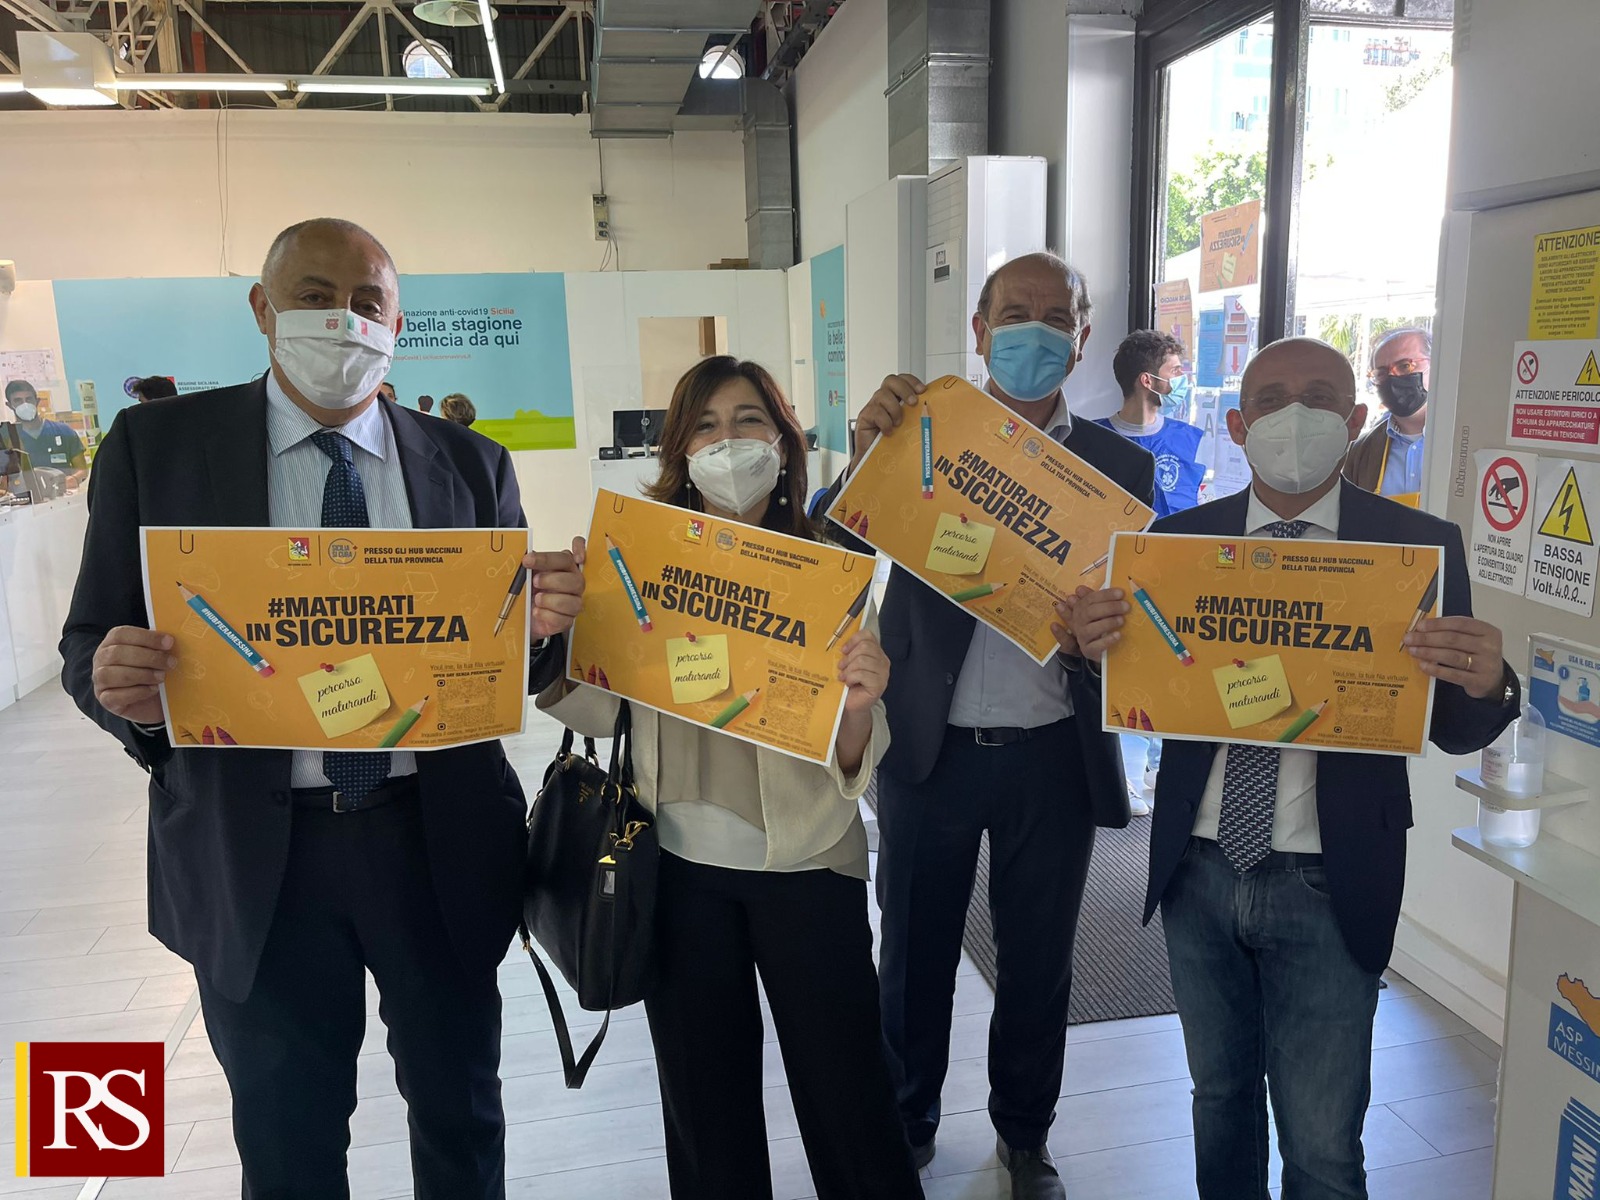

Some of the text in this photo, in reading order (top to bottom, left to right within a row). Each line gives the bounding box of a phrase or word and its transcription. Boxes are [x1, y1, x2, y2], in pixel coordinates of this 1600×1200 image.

[1538, 231, 1600, 253] ATTENZIONE
[440, 308, 488, 316] anti-covid19
[490, 307, 514, 316] Sicilia
[406, 316, 522, 334] bella stagione
[468, 332, 489, 346] da
[494, 332, 520, 348] qui
[1516, 390, 1560, 400] ATTENZIONE
[1516, 418, 1538, 426] SCHIUMA
[1546, 420, 1595, 430] APPARECCHIATURE
[1544, 410, 1570, 418] ESTINTORI
[1571, 410, 1586, 419] IDRICI
[1523, 428, 1586, 440] ELETTRICHE IN TENSIONE
[958, 449, 1054, 521] #MATURATI
[1040, 461, 1091, 498] DELLA TUA PROVINCIA
[1045, 454, 1107, 500] PRESSO GLI HUB VACCINALI
[934, 454, 1073, 566] IN SICUREZZA
[940, 527, 978, 546] percorso
[1488, 534, 1497, 543] NON
[404, 556, 444, 564] PROVINCIA
[424, 546, 463, 554] VACCINALI
[740, 549, 802, 570] DELLA TUA PROVINCIA
[742, 540, 764, 552] PRESSO
[789, 552, 820, 566] VACCINALI
[934, 544, 980, 564] maturandi
[1498, 548, 1506, 559] DEL
[1506, 550, 1524, 564] QUADRO
[1544, 544, 1582, 566] BASSA
[1310, 556, 1322, 564] GLI
[1338, 558, 1374, 566] VACCINALI
[1318, 566, 1355, 574] PROVINCIA
[1505, 563, 1516, 574] SOLO
[1478, 568, 1488, 578] AGLI
[1534, 560, 1590, 586] TENSIONE
[660, 564, 771, 609] #MATURATI
[268, 594, 414, 618] #MATURATI
[641, 580, 806, 647] IN SICUREZZA
[1195, 596, 1324, 622] #MATURATI
[200, 607, 254, 659] #HUBFIERAMESSINA
[246, 616, 470, 647] IN SICUREZZA
[1143, 599, 1180, 648] #HUBFIERAMESSINA
[1176, 616, 1374, 653] IN SICUREZZA
[674, 650, 714, 668] percorso
[1568, 654, 1578, 664] USA
[1584, 659, 1594, 668] GEL
[674, 668, 722, 683] maturandi
[1226, 674, 1268, 694] percorso
[317, 676, 364, 703] percorso
[1228, 688, 1281, 710] maturandi
[320, 690, 378, 718] maturandi
[1556, 1021, 1584, 1045] ASP
